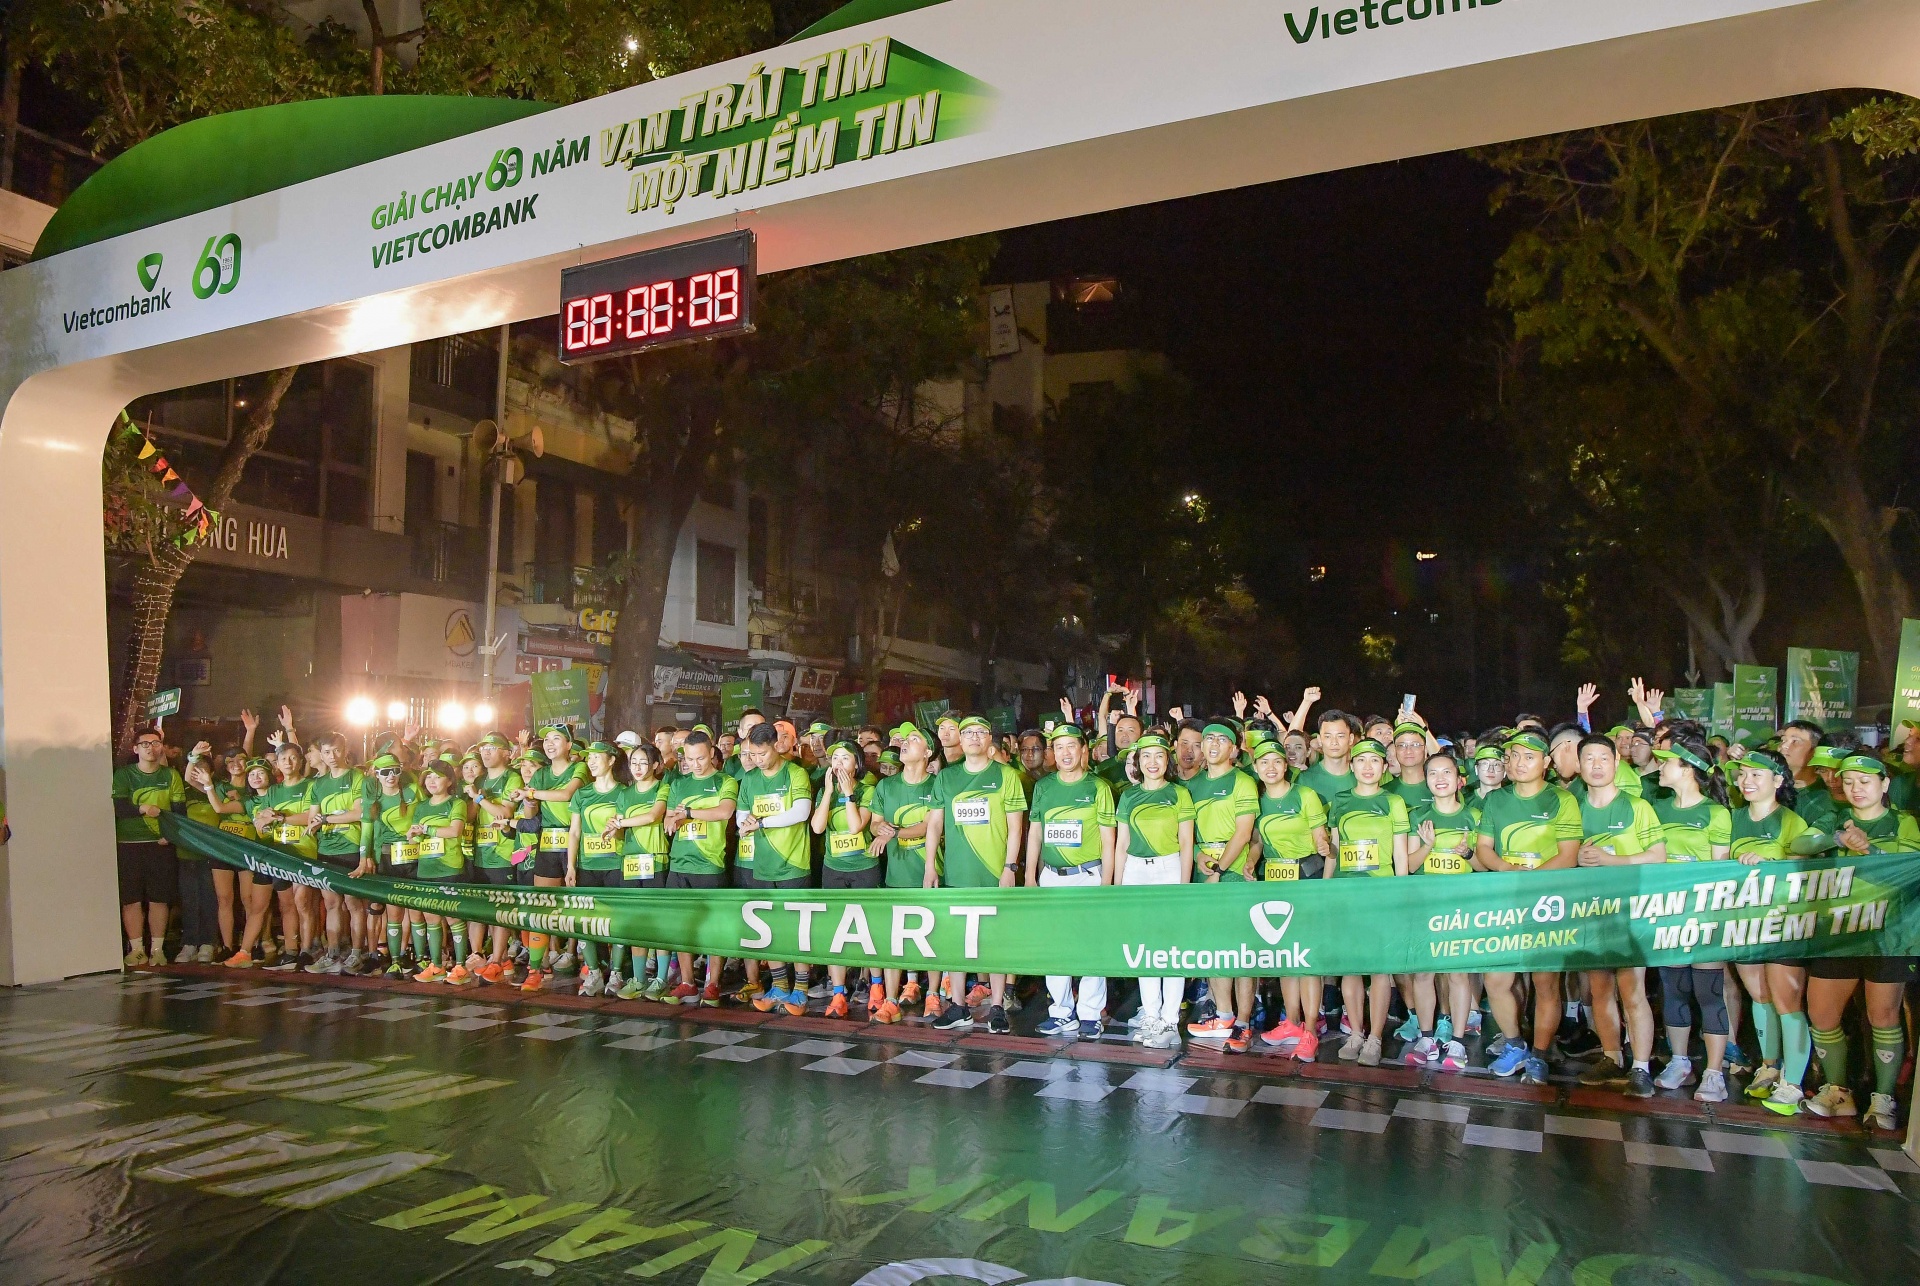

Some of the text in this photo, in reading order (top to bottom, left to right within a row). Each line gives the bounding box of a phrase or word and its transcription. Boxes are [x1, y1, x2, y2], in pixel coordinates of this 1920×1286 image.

[600, 35, 891, 170] VẠN TRÁI TIM
[627, 89, 941, 214] MỘT NIỀM TIN
[371, 136, 590, 230] GIẢI CHẠY 60 NĂM
[371, 193, 539, 269] VIETCOMBANK
[192, 233, 241, 299] 60
[63, 287, 172, 333] Vietcombank
[249, 521, 288, 560] HUA
[756, 802, 781, 813] 10069
[957, 807, 986, 818] 99999
[834, 837, 859, 849] 10517
[1047, 829, 1078, 839] 68686
[243, 853, 334, 892] Vietcombank
[626, 862, 651, 872] 10566
[1343, 850, 1373, 862] 10124
[1429, 857, 1461, 870] 10136
[1267, 868, 1295, 879] 10009
[387, 893, 461, 912] VIETCOMBANK
[1629, 866, 1855, 924] VẠN TRÁI TIM
[580, 916, 611, 937] TIN
[739, 900, 997, 959] START
[1428, 895, 1621, 932] GIẢI CHẠY 60 NĂM
[1652, 899, 1888, 953] MỘT NIỀM TIN
[1122, 941, 1311, 970] Vietcombank
[1430, 928, 1578, 958] VIETCOMBANK
